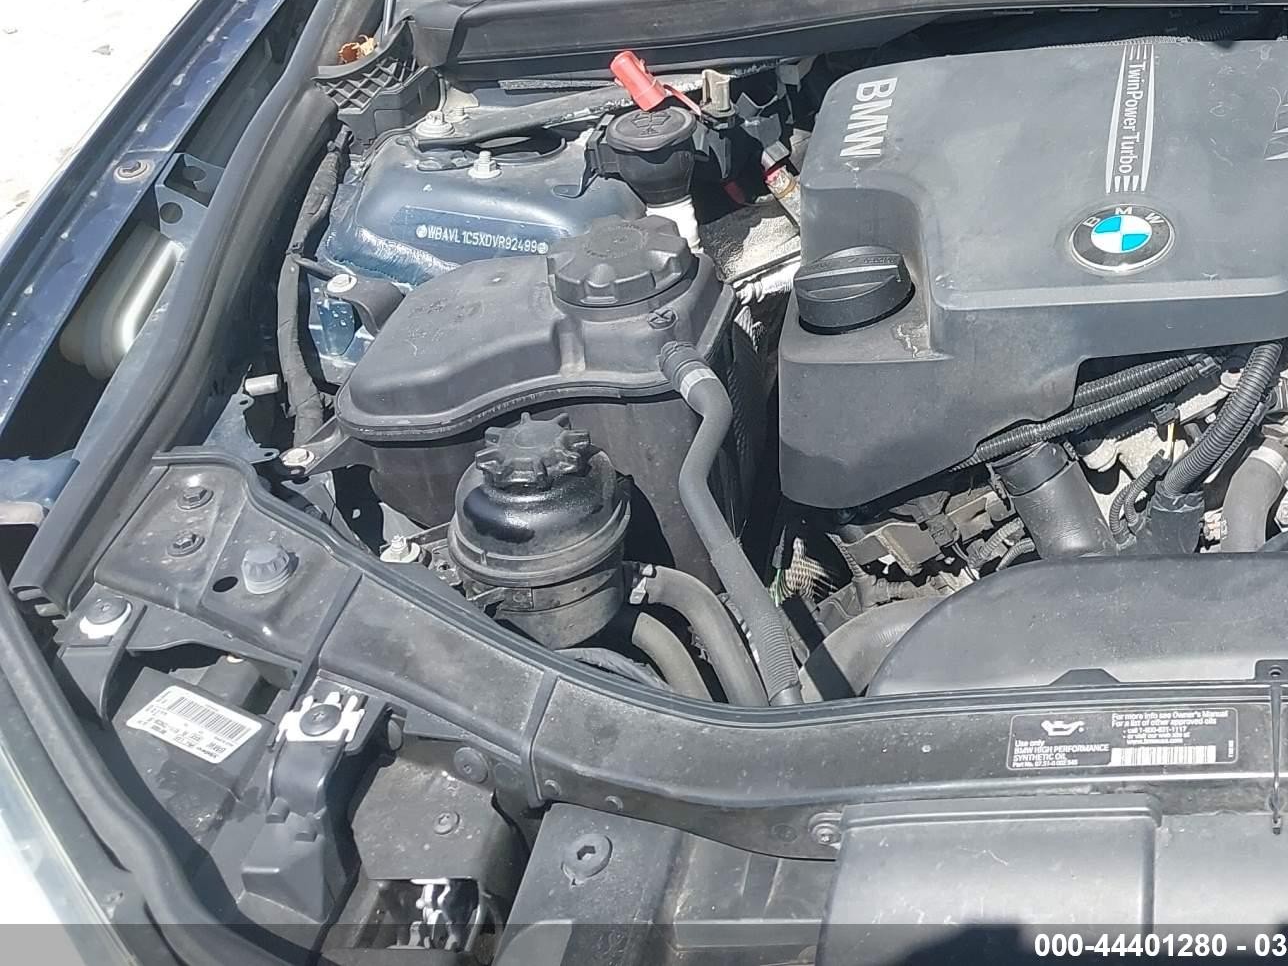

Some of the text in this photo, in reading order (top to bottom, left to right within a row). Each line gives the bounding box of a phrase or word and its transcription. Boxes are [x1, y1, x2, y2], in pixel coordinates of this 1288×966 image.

[840, 77, 898, 156] BMW
[1118, 61, 1146, 174] TwinPower Turbo
[1083, 206, 1164, 228] BMW
[1014, 743, 1110, 754] BMW HIGH PERFORMANCE
[1029, 739, 1045, 748] only
[1013, 753, 1055, 762] SYNTHETIC
